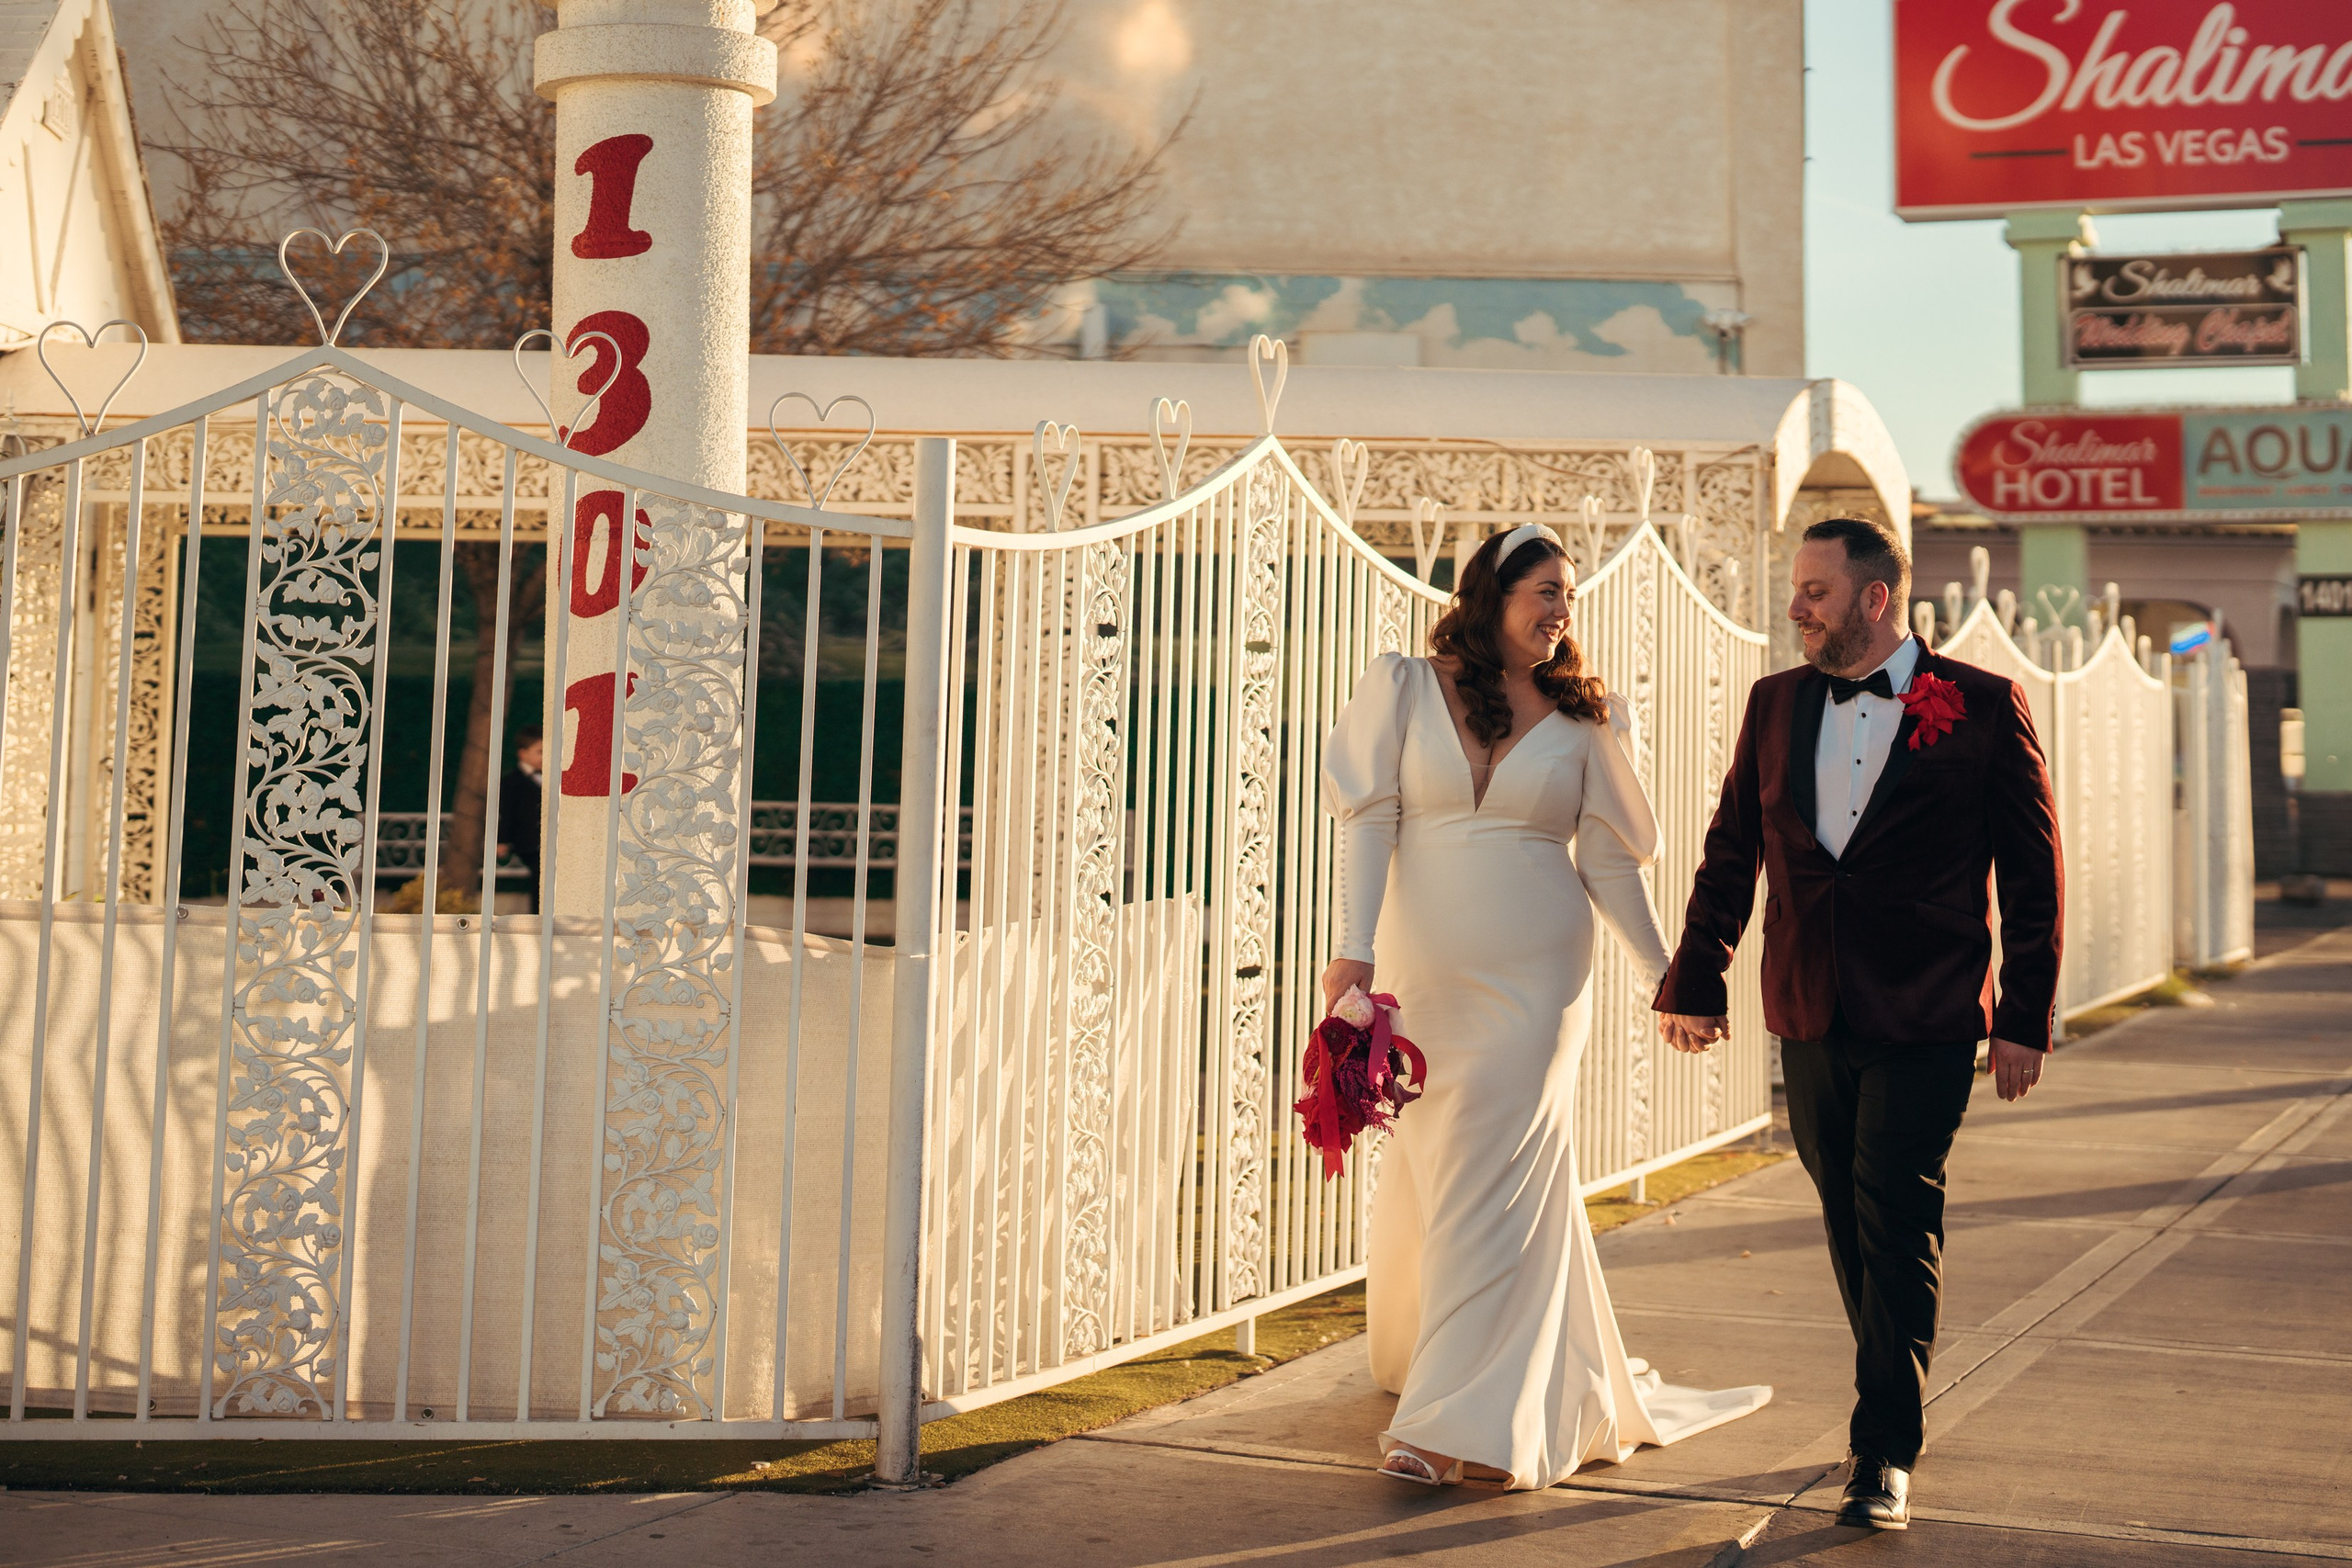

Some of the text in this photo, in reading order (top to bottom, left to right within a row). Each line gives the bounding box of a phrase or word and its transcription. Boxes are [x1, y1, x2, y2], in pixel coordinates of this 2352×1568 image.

[2074, 126, 2290, 169] LAS VEGAS
[2197, 423, 2352, 479] AQU
[1994, 468, 2159, 504] HOTEL
